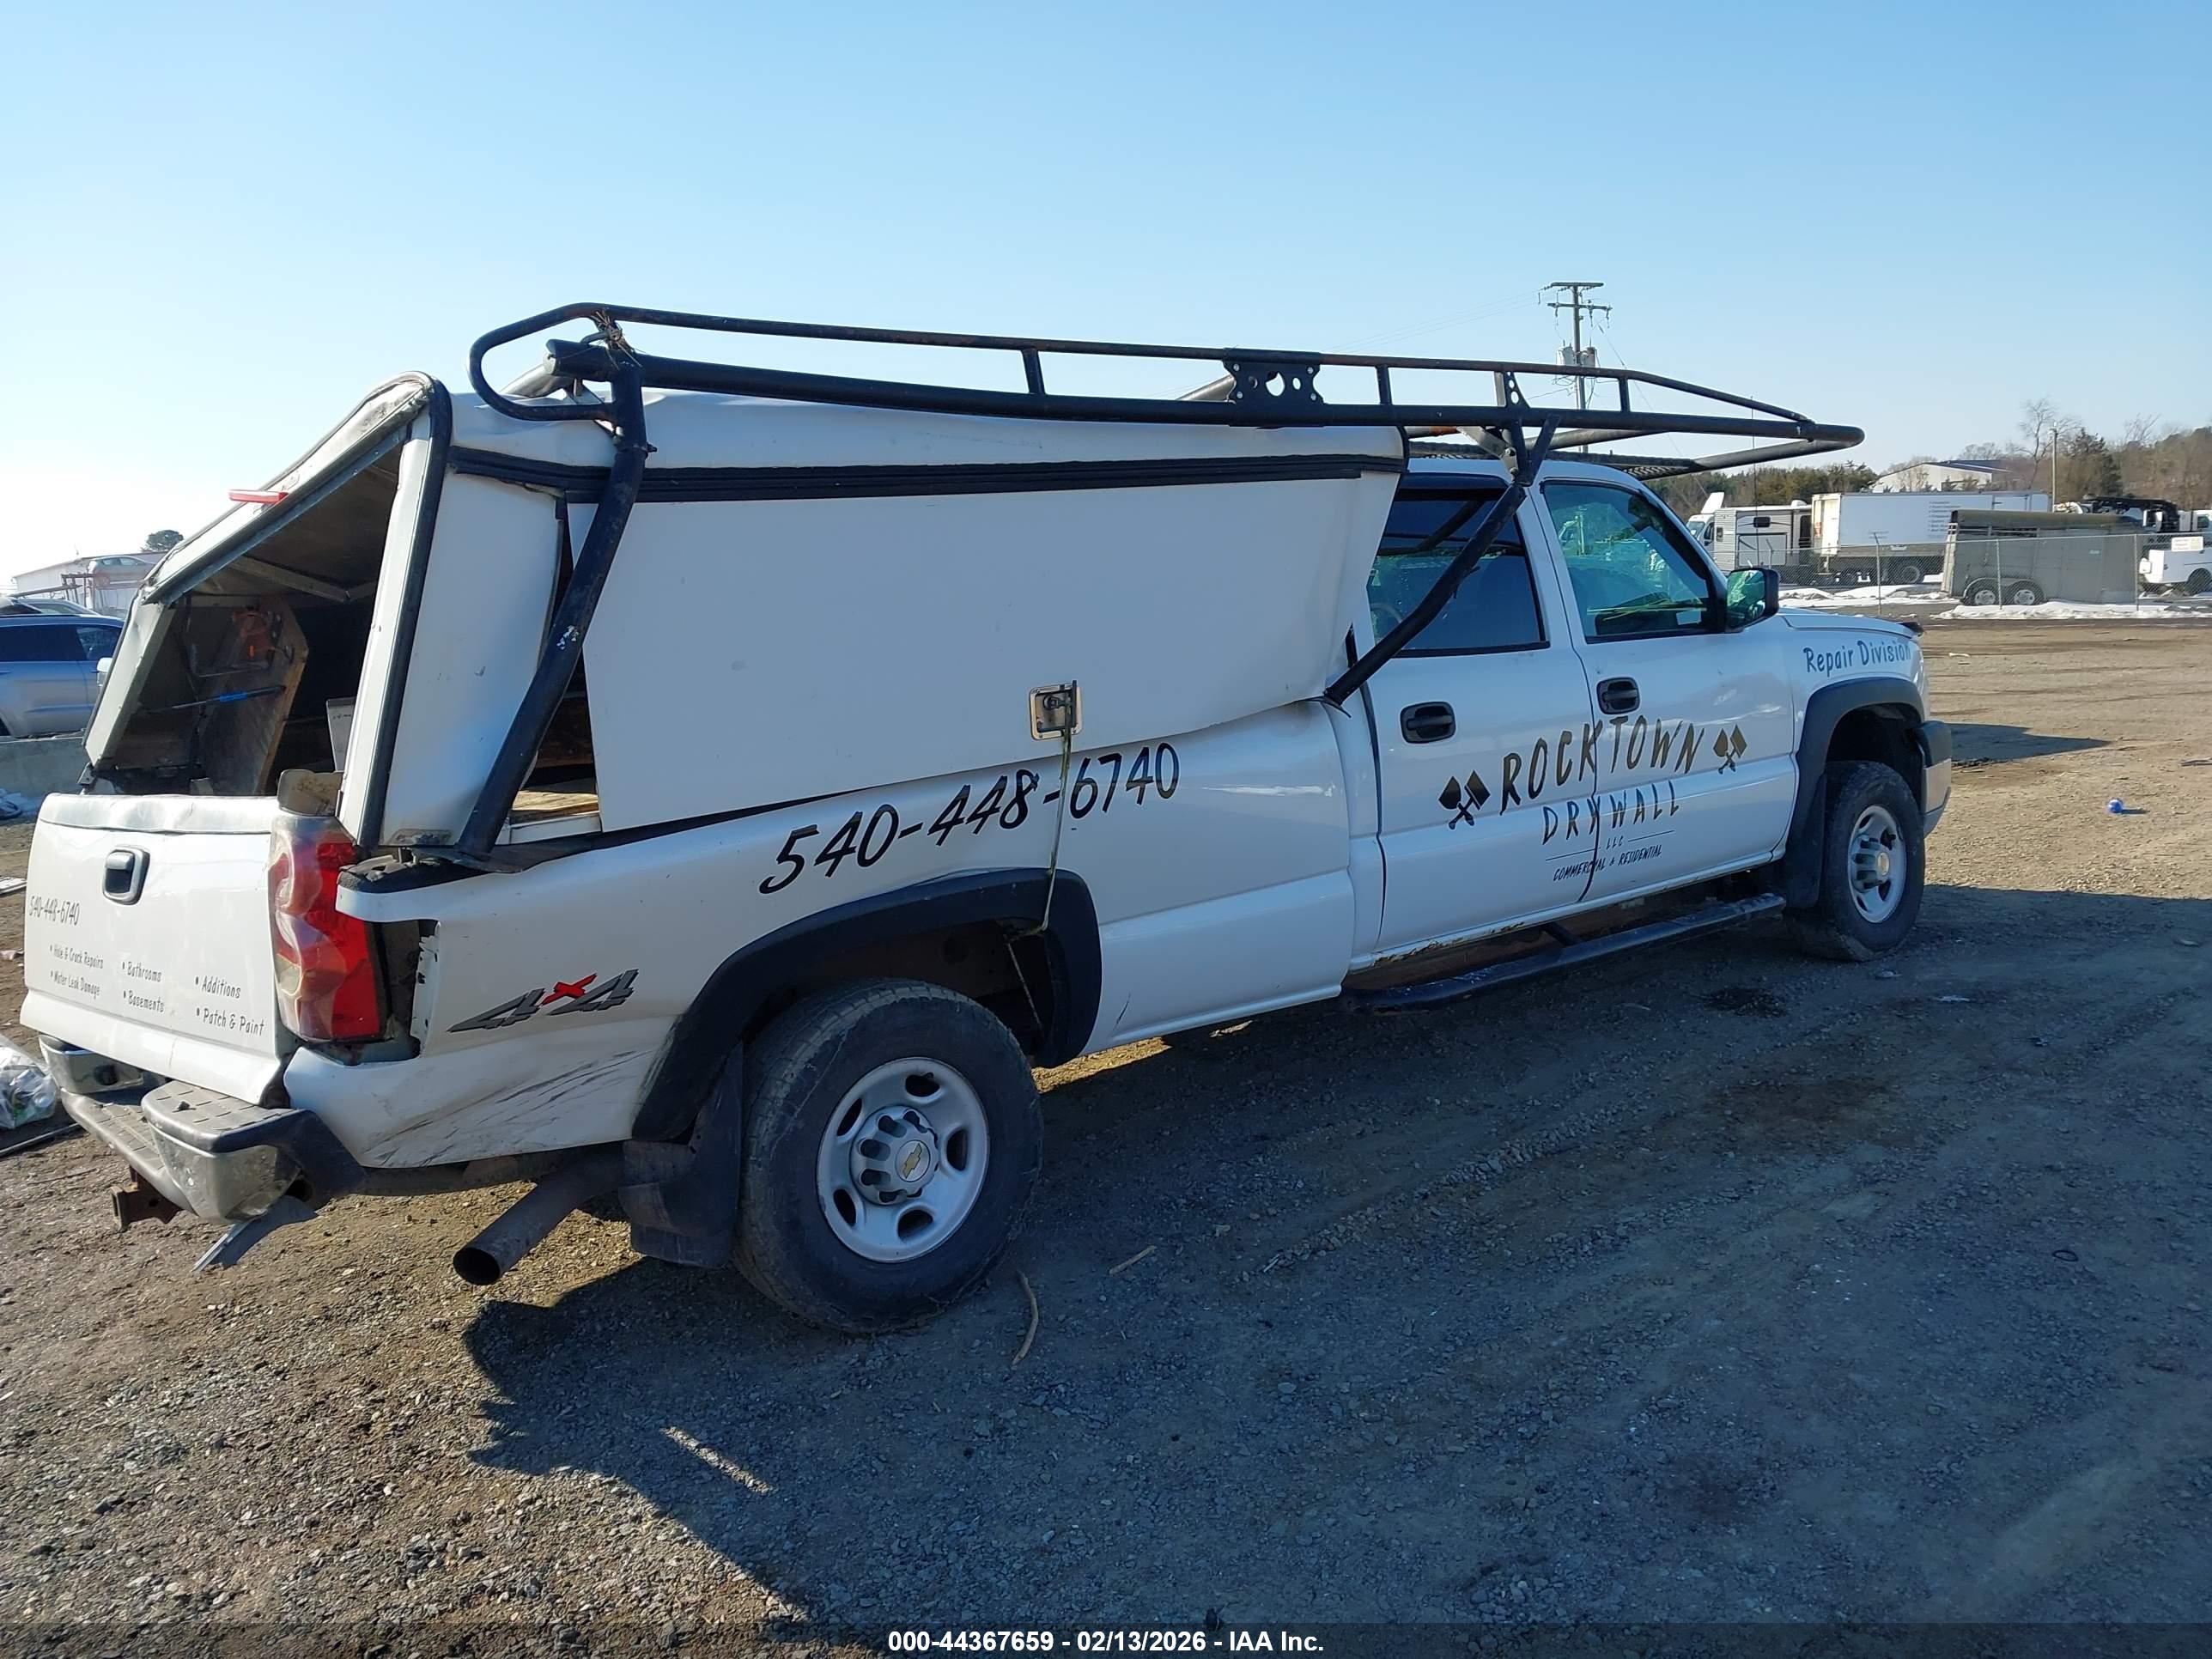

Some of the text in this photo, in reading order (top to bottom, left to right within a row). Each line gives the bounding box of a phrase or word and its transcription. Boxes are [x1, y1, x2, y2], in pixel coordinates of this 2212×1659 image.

[1803, 640, 1911, 677] Repair Division
[1499, 714, 1705, 816] ROCKTOWN
[759, 743, 1180, 895] 540-448-6740
[1542, 780, 1680, 845] DRYWALL
[1607, 836, 1624, 849] LLC
[1618, 844, 1662, 866] RESIDENTIAL
[29, 895, 80, 926] 540-448-6740
[69, 947, 83, 963] Crack
[83, 951, 104, 969] Repairs
[127, 961, 162, 983] Bathrooms
[54, 970, 100, 1000] Water Leak Damage
[202, 975, 241, 999] Additions
[128, 989, 165, 1013] Basements
[204, 1007, 264, 1036] Patch & Paint
